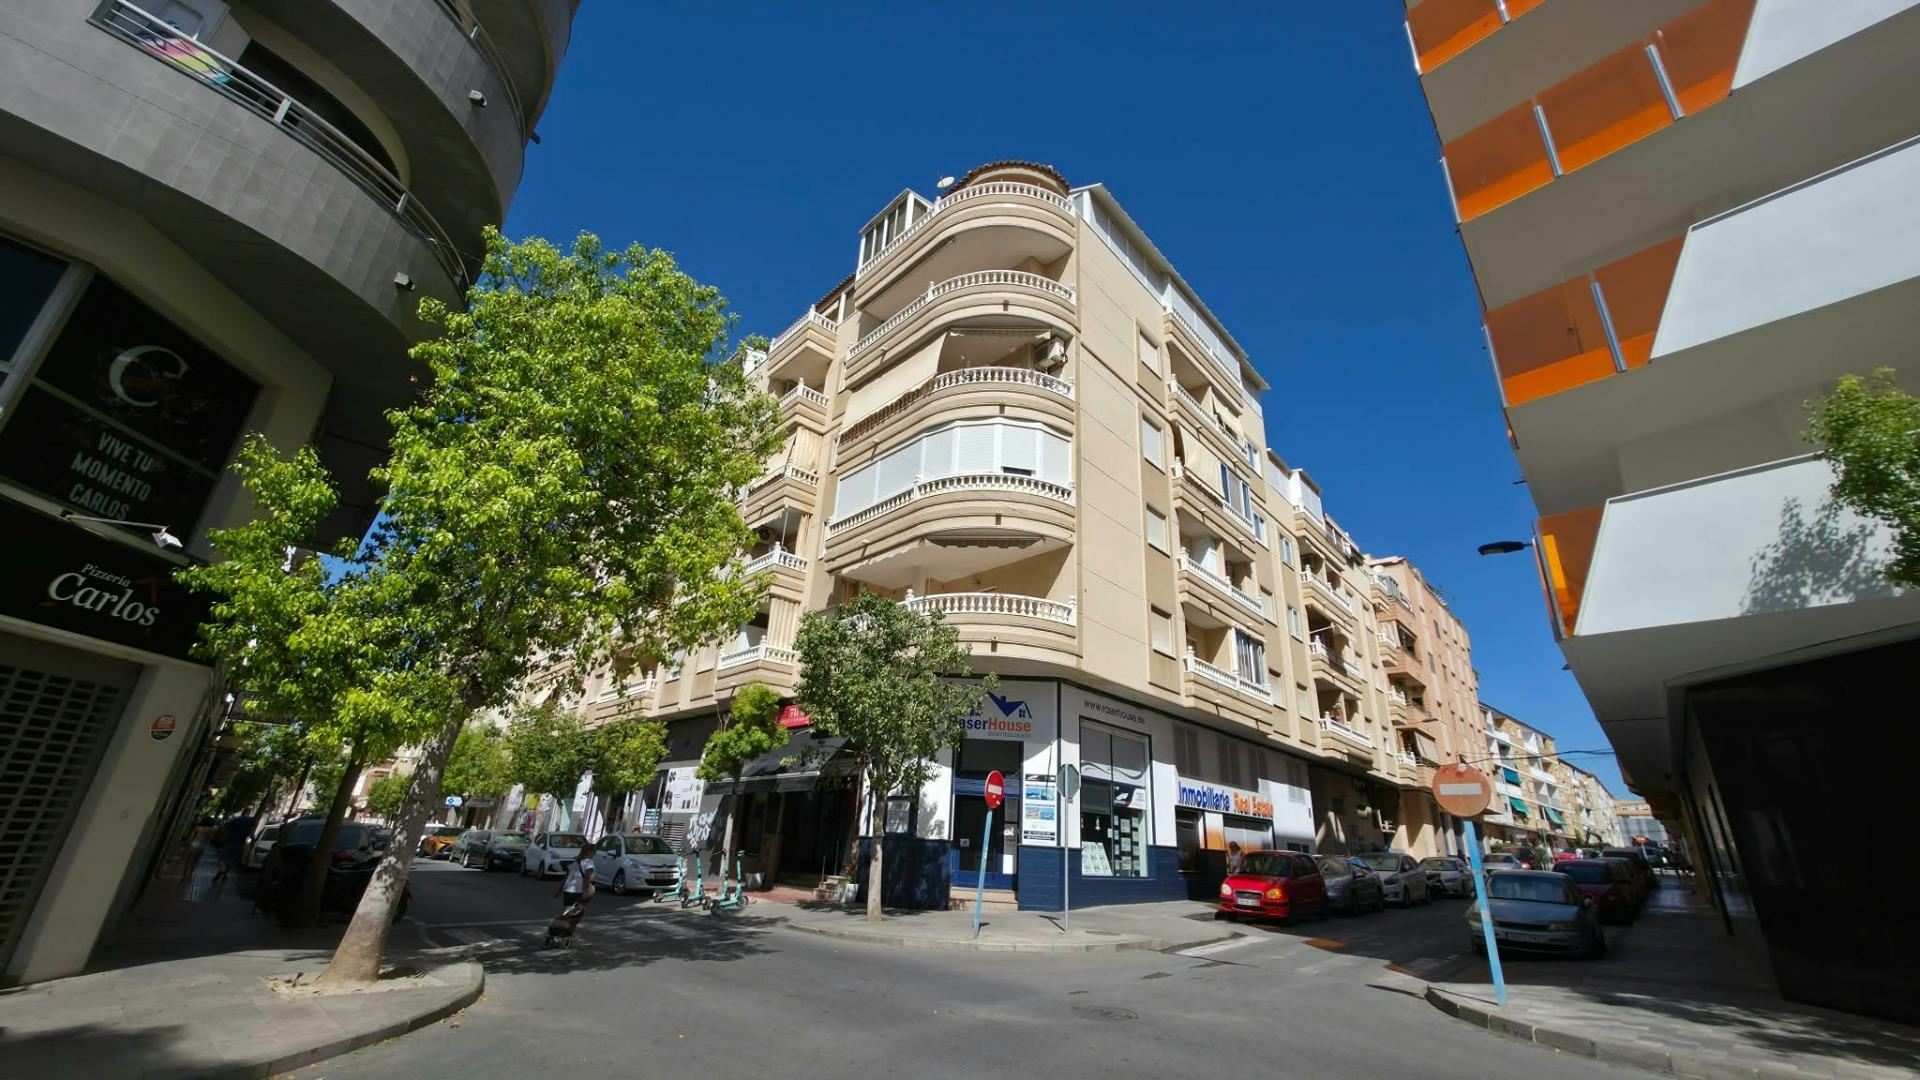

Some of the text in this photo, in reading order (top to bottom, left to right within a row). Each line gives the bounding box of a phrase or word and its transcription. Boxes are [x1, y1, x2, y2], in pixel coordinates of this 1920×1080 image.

[96, 432, 155, 473] VIVE TU
[70, 451, 152, 502] MOMENTO
[68, 482, 131, 521] CARLOS
[80, 563, 133, 588] Pizzeria
[48, 572, 161, 627] Carlos
[956, 716, 1032, 732] aserHouse
